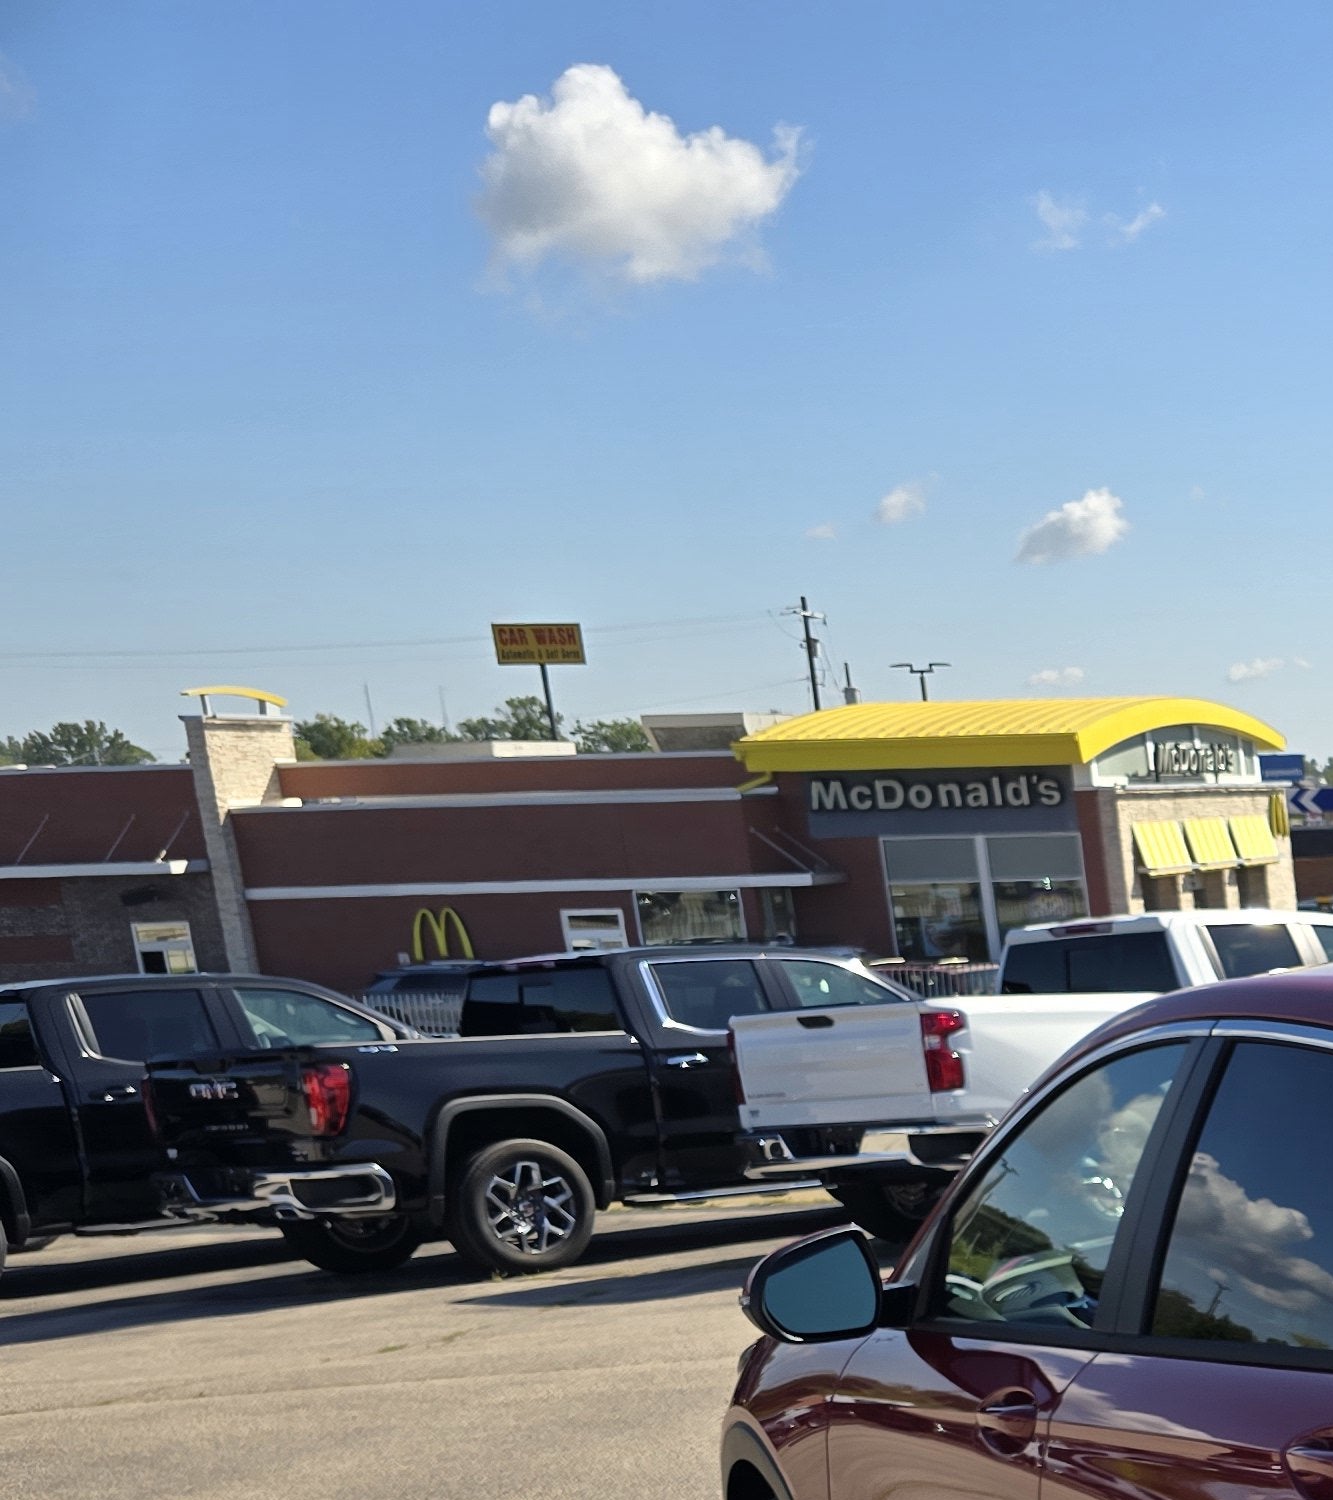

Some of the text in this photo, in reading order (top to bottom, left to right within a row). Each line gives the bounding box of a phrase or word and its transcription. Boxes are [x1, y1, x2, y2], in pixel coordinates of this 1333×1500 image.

[497, 626, 577, 646] CAR WASH
[810, 774, 1063, 811] McDonald's
